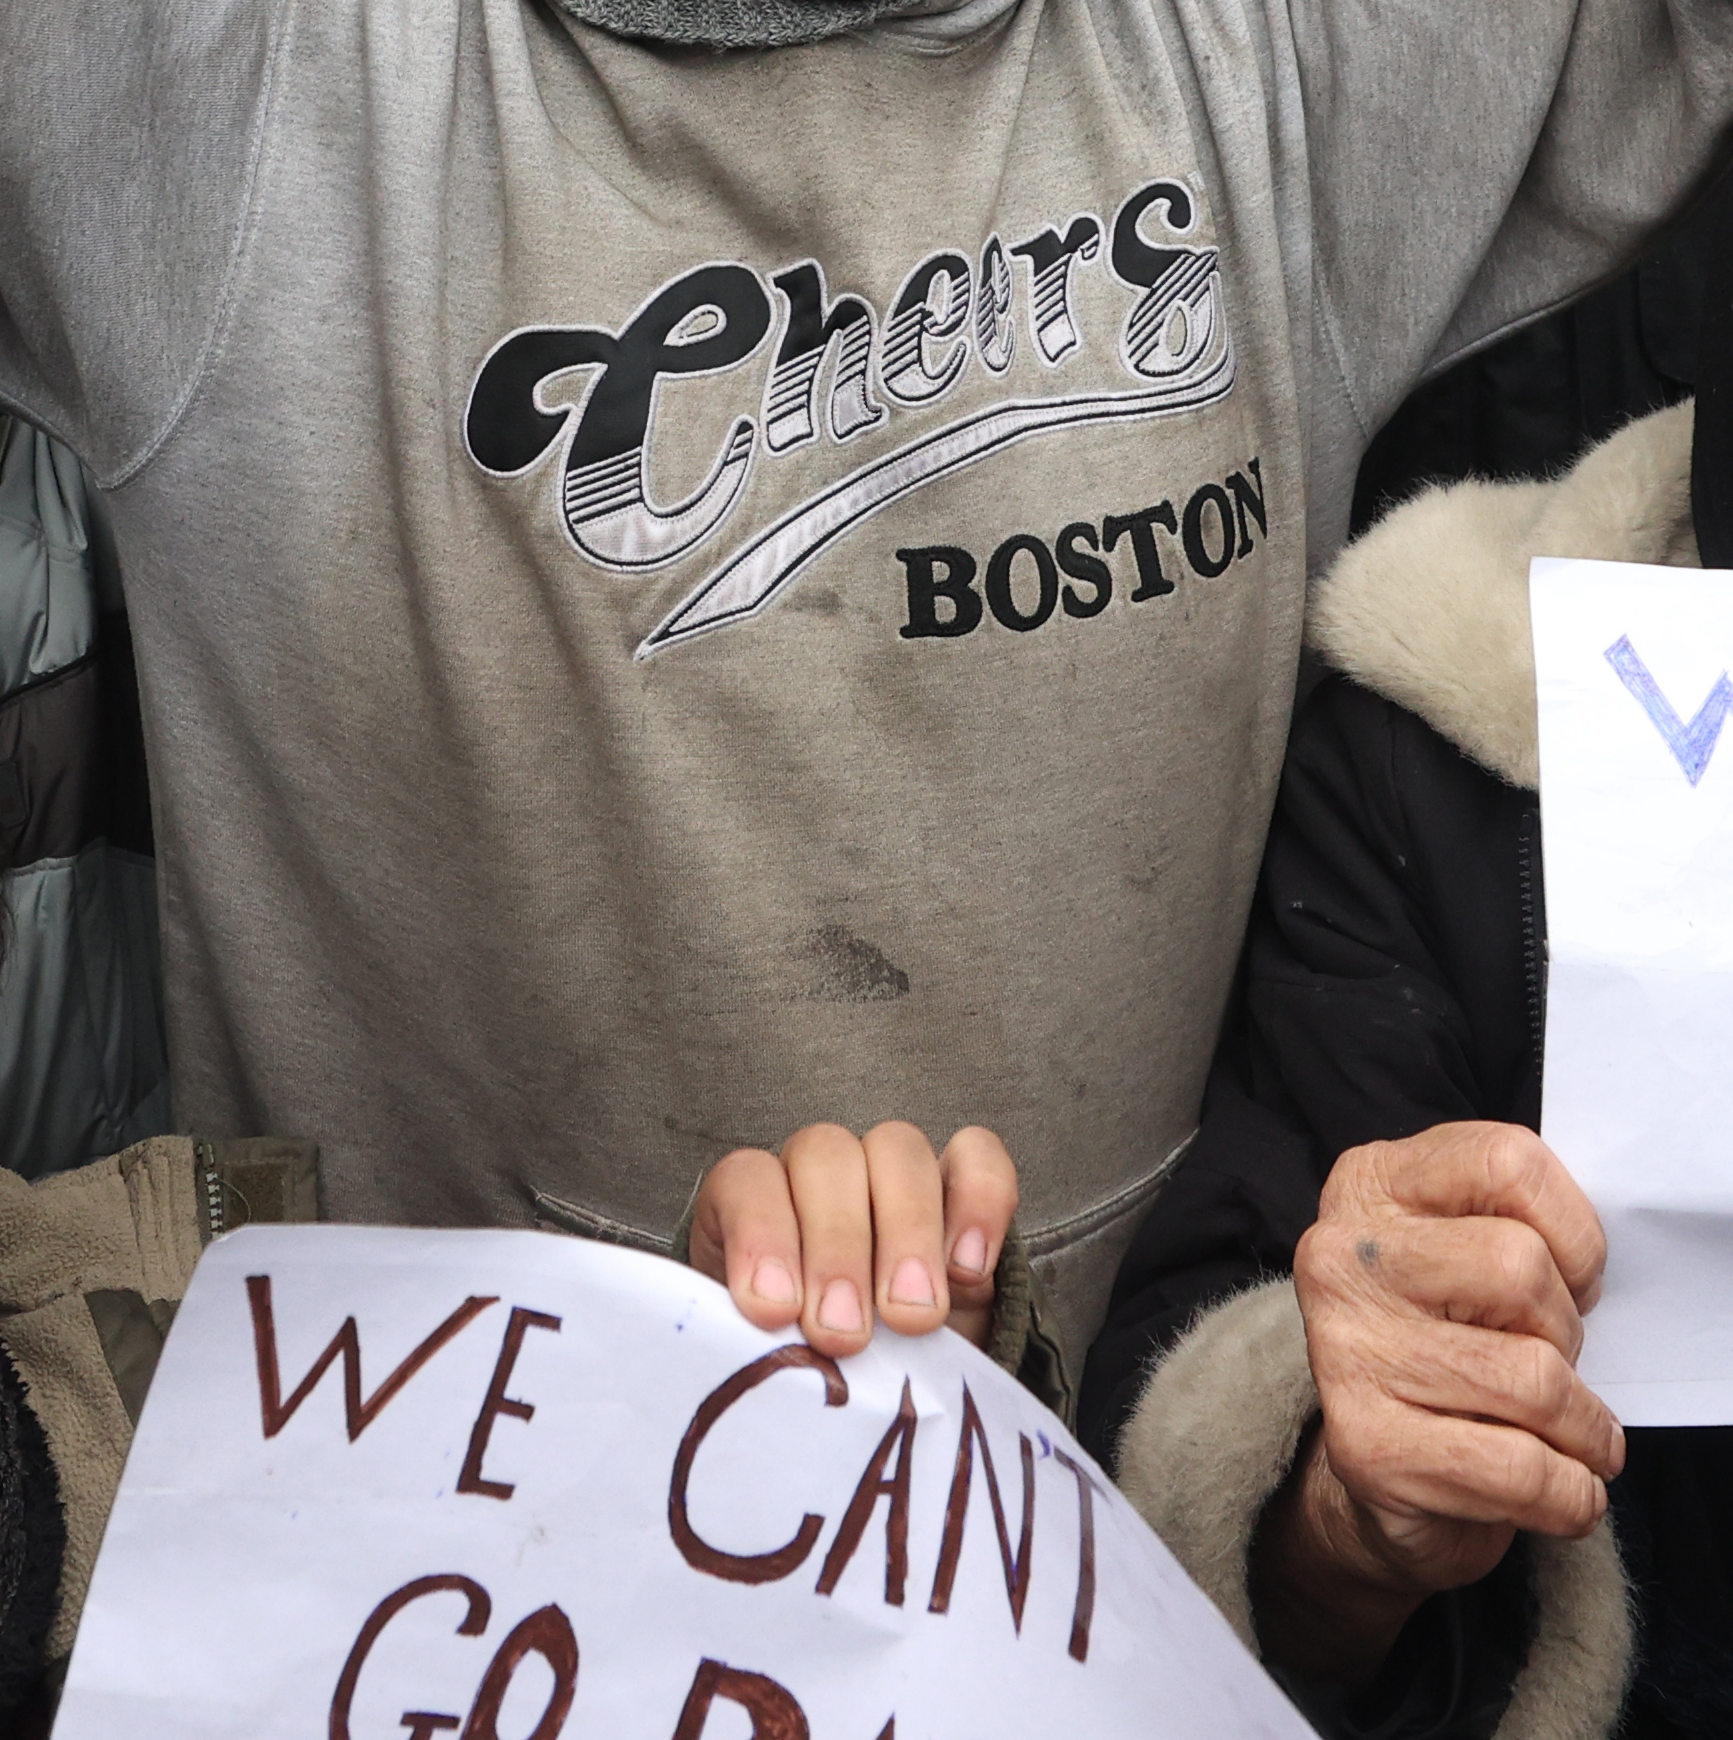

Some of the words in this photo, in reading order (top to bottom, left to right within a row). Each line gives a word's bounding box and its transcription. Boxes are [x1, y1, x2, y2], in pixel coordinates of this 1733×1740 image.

[896, 457, 1267, 640] BOSTON
[246, 1274, 562, 1500] WE
[667, 1343, 1109, 1665] CAN'T
